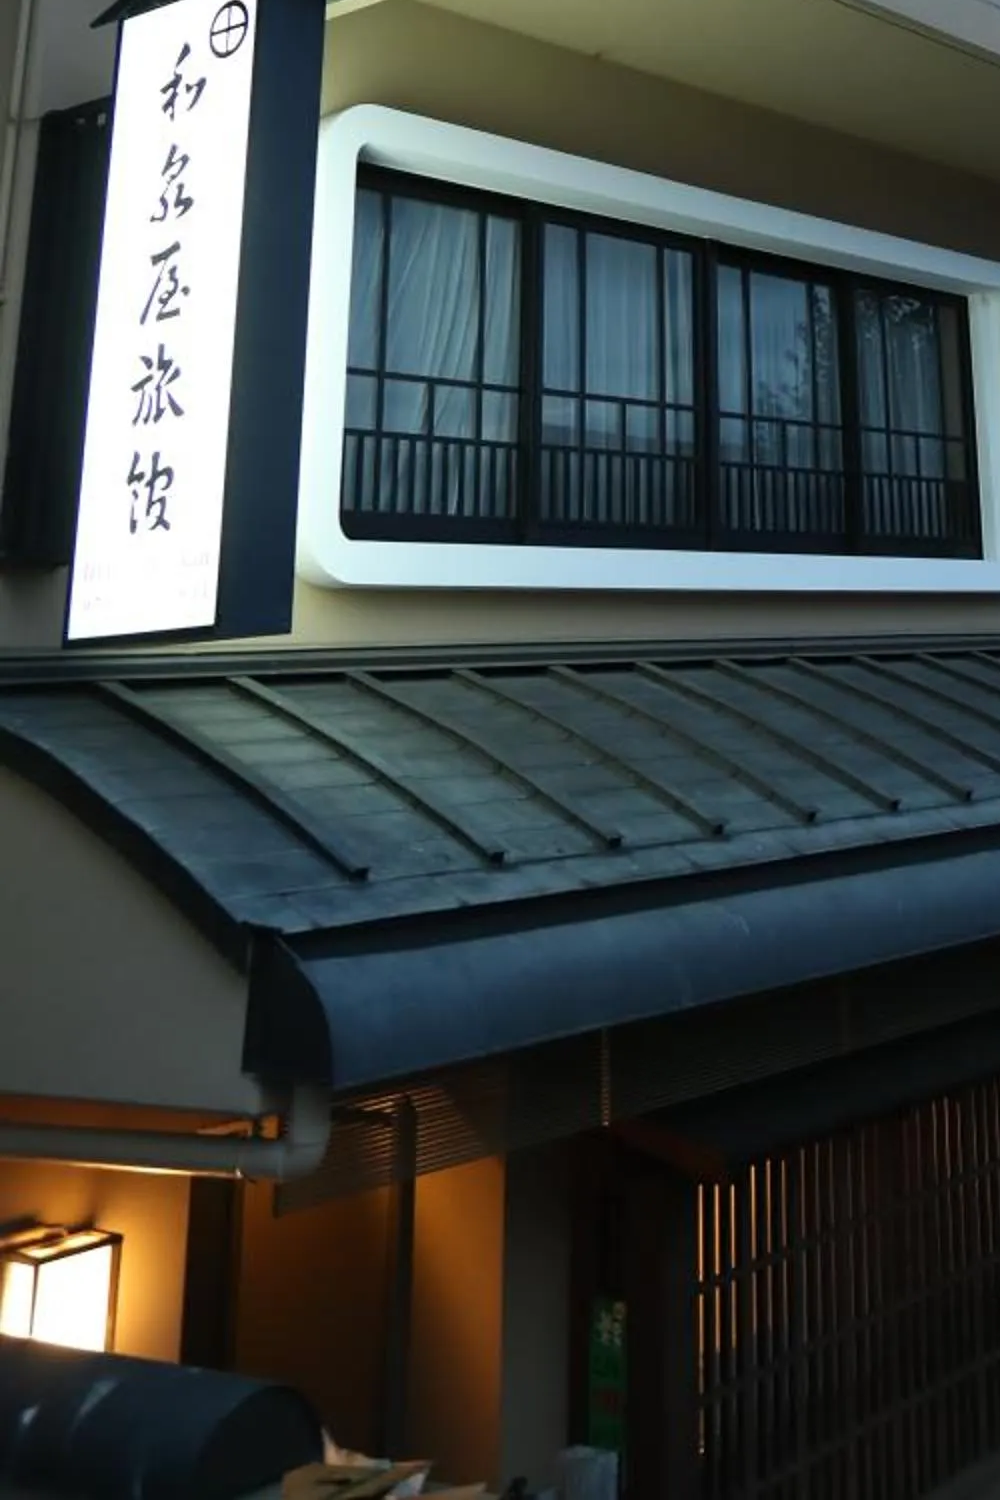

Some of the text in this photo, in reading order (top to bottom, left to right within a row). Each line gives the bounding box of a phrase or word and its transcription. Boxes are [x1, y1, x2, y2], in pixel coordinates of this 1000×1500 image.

[126, 42, 206, 535] 和泉屋旅館
